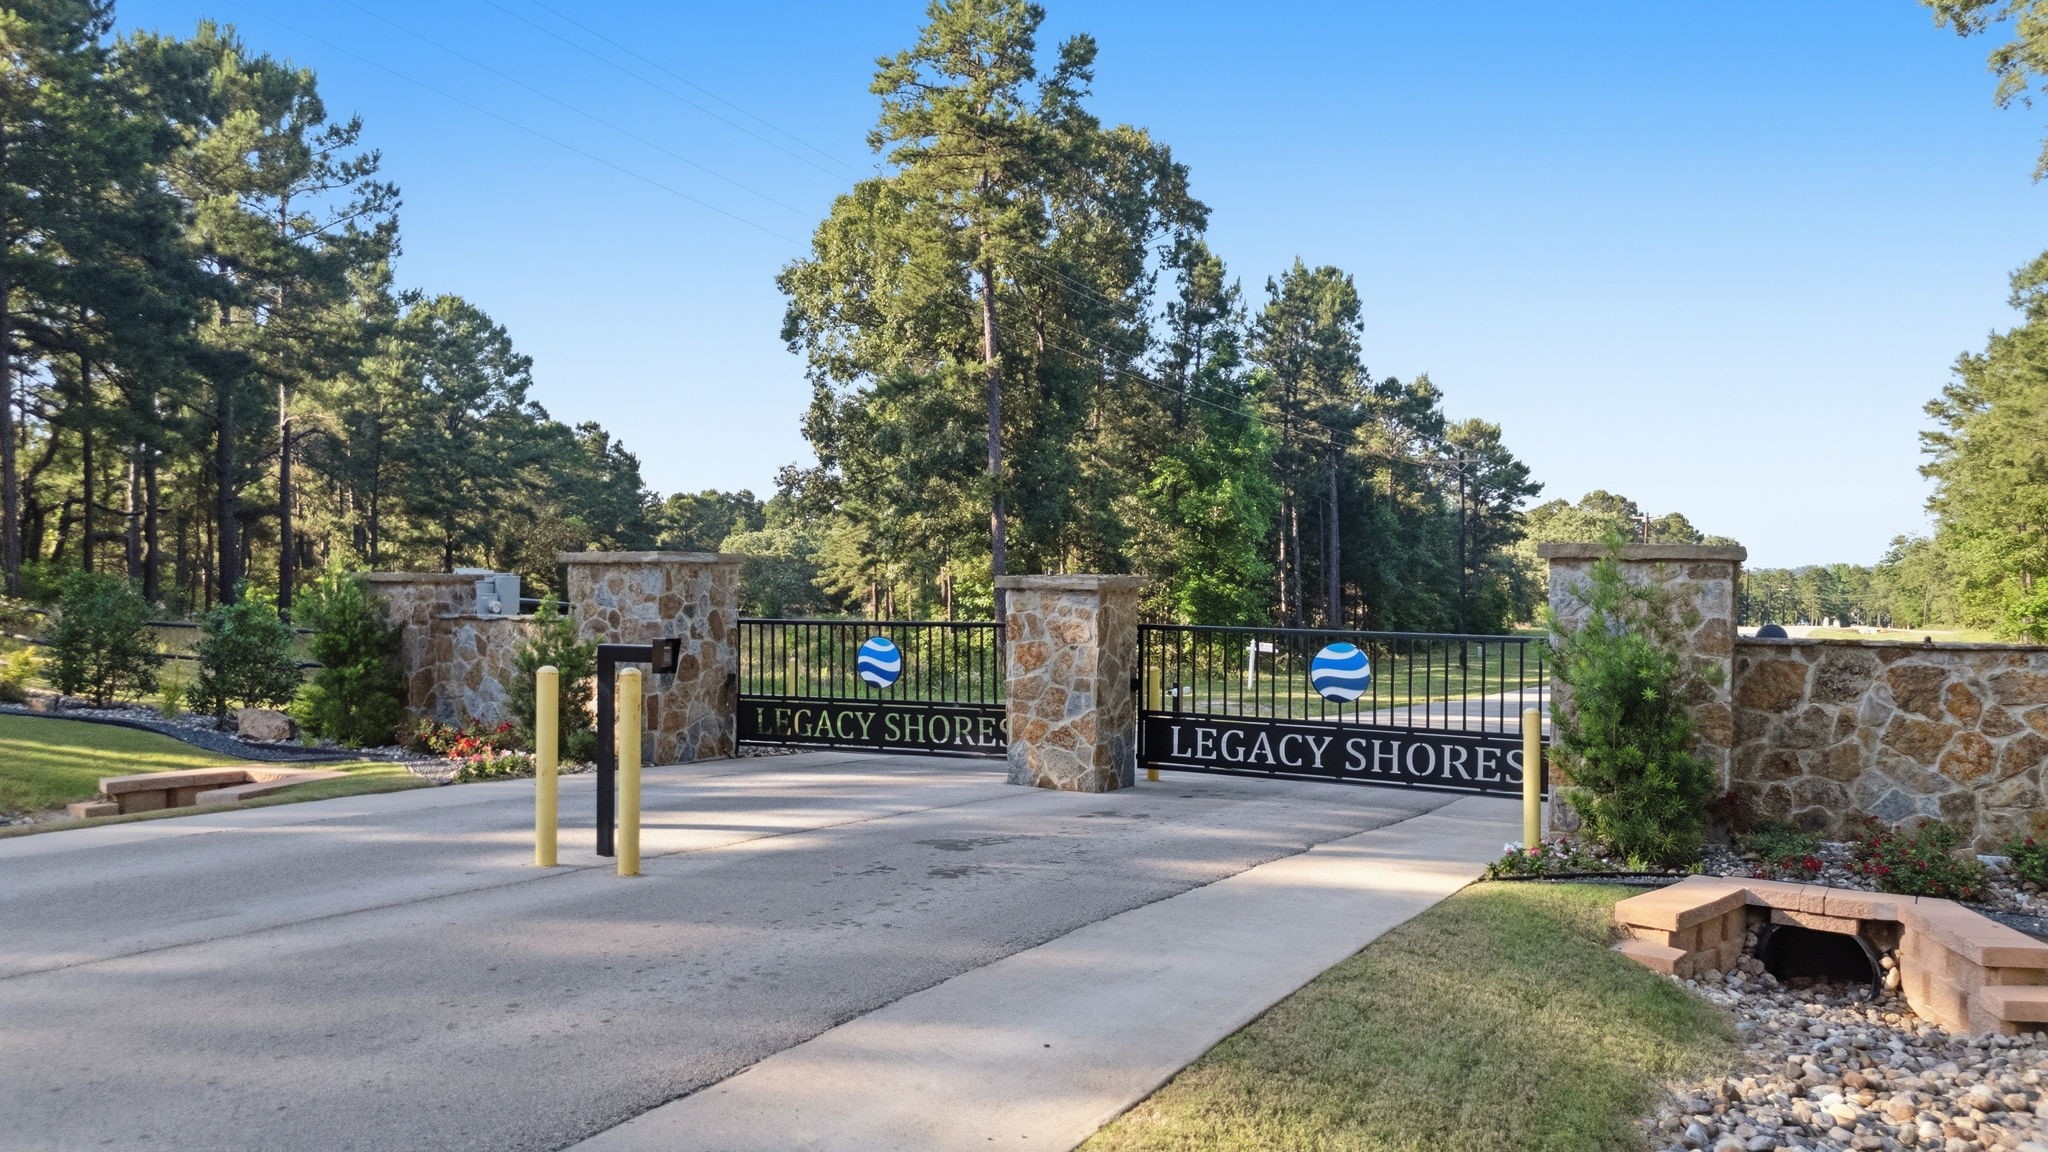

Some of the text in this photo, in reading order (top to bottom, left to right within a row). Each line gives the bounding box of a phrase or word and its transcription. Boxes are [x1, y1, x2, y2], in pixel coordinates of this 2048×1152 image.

[756, 707, 876, 740] LEGACY
[1170, 725, 1524, 784] LEGACY SHORES
